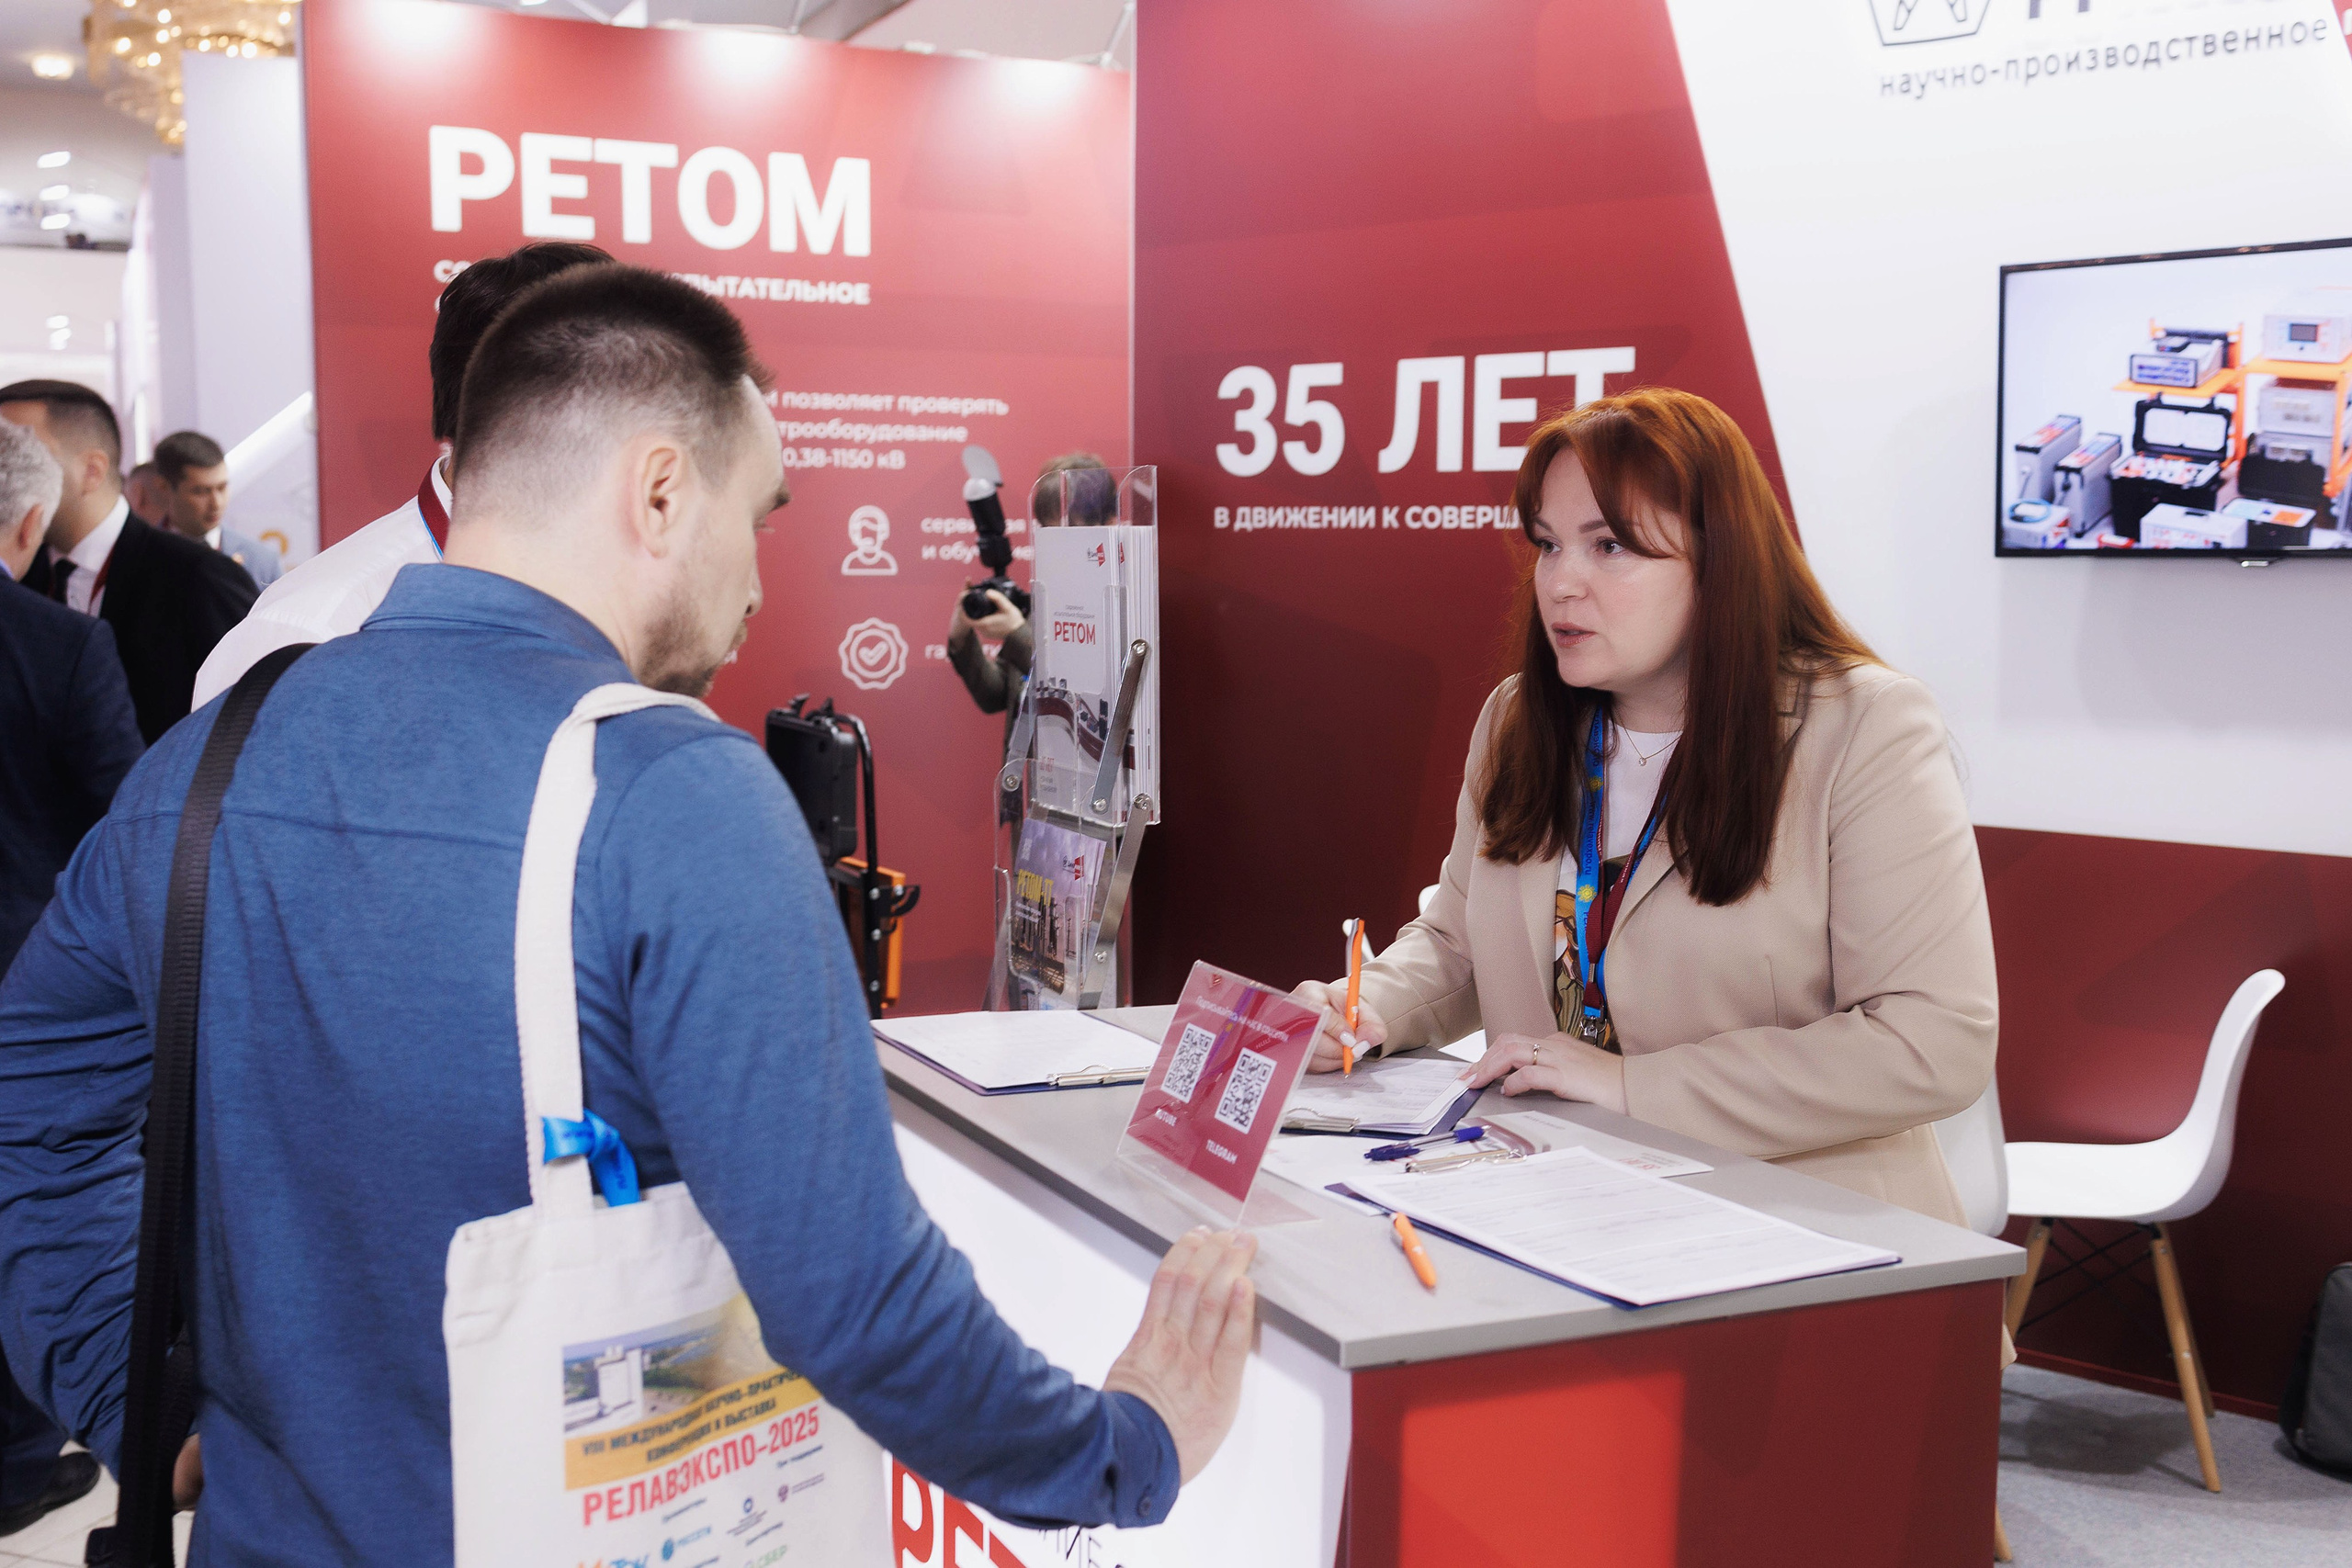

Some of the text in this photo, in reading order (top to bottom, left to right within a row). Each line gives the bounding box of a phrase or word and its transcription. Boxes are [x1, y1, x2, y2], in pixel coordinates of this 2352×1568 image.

[1881, 17, 2328, 99] научно-производственное
[429, 125, 871, 256] РЕТОМ
[782, 391, 895, 412] позволяет
[898, 395, 1010, 417] проверять
[1216, 346, 1635, 477] 35 ЛЕТ
[1214, 504, 1521, 531] В ДВИЖЕНИИ К СОВЕРШ
[1054, 621, 1096, 645] РЕТОМ
[1205, 1139, 1238, 1165] TELEGRAM
[582, 1405, 821, 1527] РЕЛАВЭКСПО-2025
